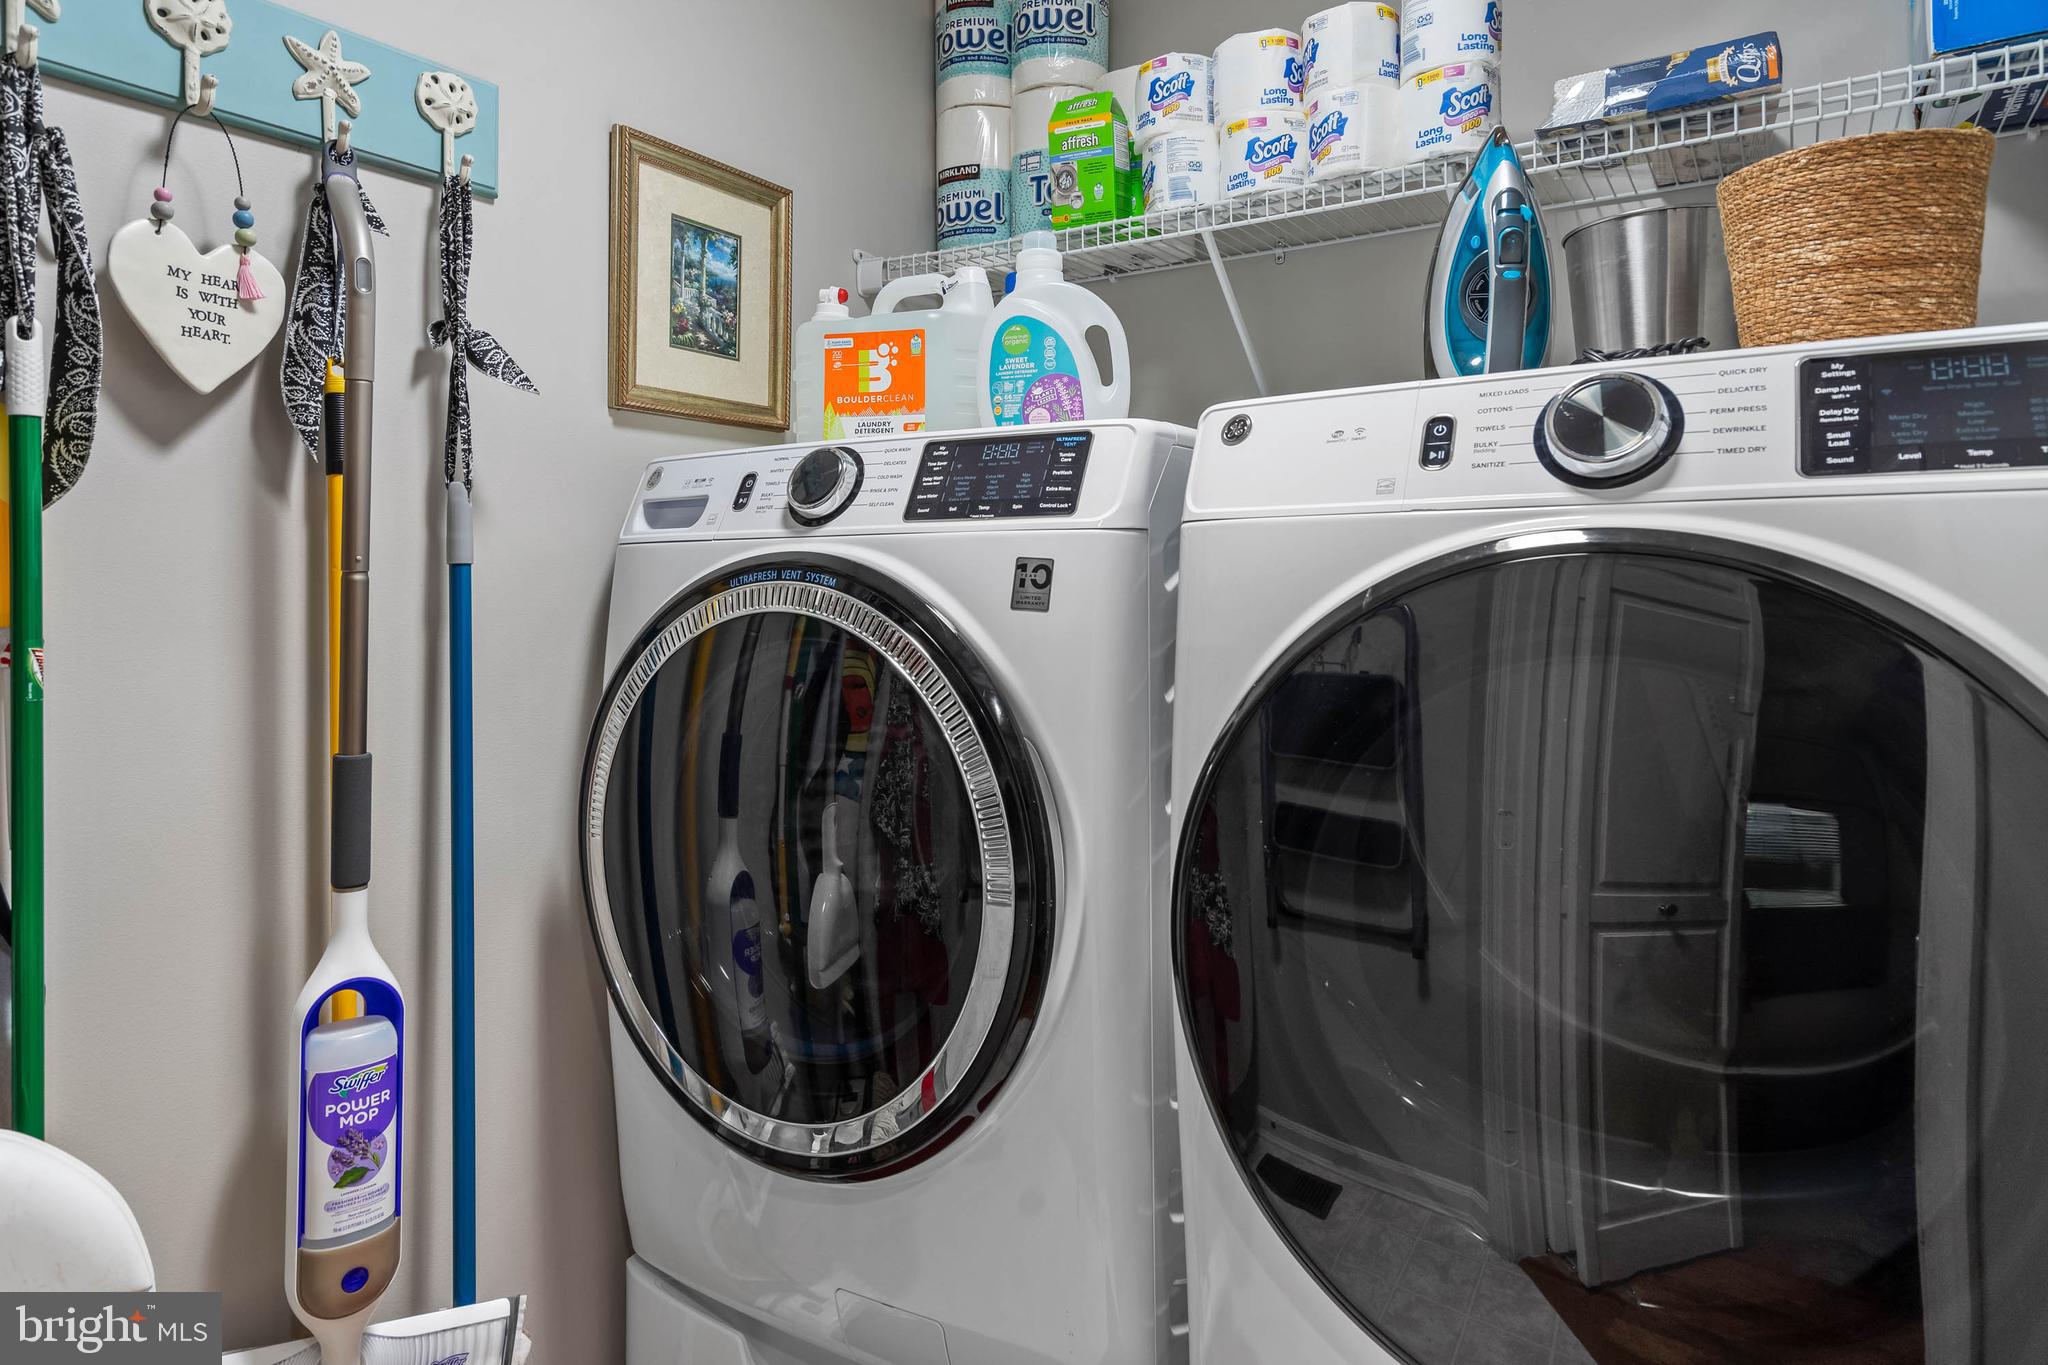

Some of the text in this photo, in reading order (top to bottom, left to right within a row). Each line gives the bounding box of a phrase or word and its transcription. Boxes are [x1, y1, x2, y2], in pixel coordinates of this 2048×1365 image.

[945, 17, 996, 31] PREMIUM
[1461, 33, 1488, 43] Long
[1457, 41, 1495, 54] Lasting
[1382, 59, 1399, 73] Long
[1378, 67, 1400, 80] Lastin
[1152, 72, 1189, 102] Scott
[1263, 88, 1287, 97] Long
[1067, 98, 1098, 111] affresh
[1260, 96, 1294, 107] Lasting
[1446, 84, 1489, 116] Scott
[1310, 111, 1340, 151] Scott
[1460, 116, 1482, 134] 1100
[1418, 126, 1444, 139] Long
[1061, 132, 1099, 151] affresh
[1415, 133, 1452, 149] Lasting
[1251, 134, 1291, 163] Scott
[939, 165, 979, 181] KIRKLAND
[1229, 171, 1248, 182] Long
[1226, 178, 1256, 192] Lasting
[937, 191, 1005, 230] owel
[167, 265, 240, 292] MY HEAR
[176, 286, 239, 310] IS WITH
[188, 307, 226, 327] YOUR
[181, 325, 231, 345] HEART.
[998, 362, 1035, 371] LAVENDER
[1718, 366, 1768, 377] QUICK DRY
[1821, 369, 1856, 378] Settings
[1504, 388, 1529, 396] LOADS
[1717, 385, 1767, 394] DELICATES
[1814, 384, 1861, 394] Damp Alert
[837, 393, 914, 404] BOULDERCLEAN
[1477, 405, 1514, 415] COTTONS
[1709, 404, 1768, 415] PERM PRESS
[1819, 407, 1860, 416] Delay Dry
[1475, 424, 1506, 432] TOWELS
[1712, 424, 1767, 434] DEWRINKLE
[1825, 431, 1851, 439] Small
[1473, 441, 1498, 449] BULKY
[1827, 439, 1850, 447] Load
[1716, 447, 1746, 455] TIMED
[1897, 452, 1922, 460] Level
[1966, 449, 1994, 457] Temp
[1471, 461, 1506, 469] SANITIZE
[1826, 456, 1854, 464] Sound
[730, 569, 837, 588] ULTRAFRESH VENT SYSTEM
[328, 1069, 386, 1094] Swiffer
[325, 1089, 391, 1118] POWER
[339, 1108, 379, 1129] MOP
